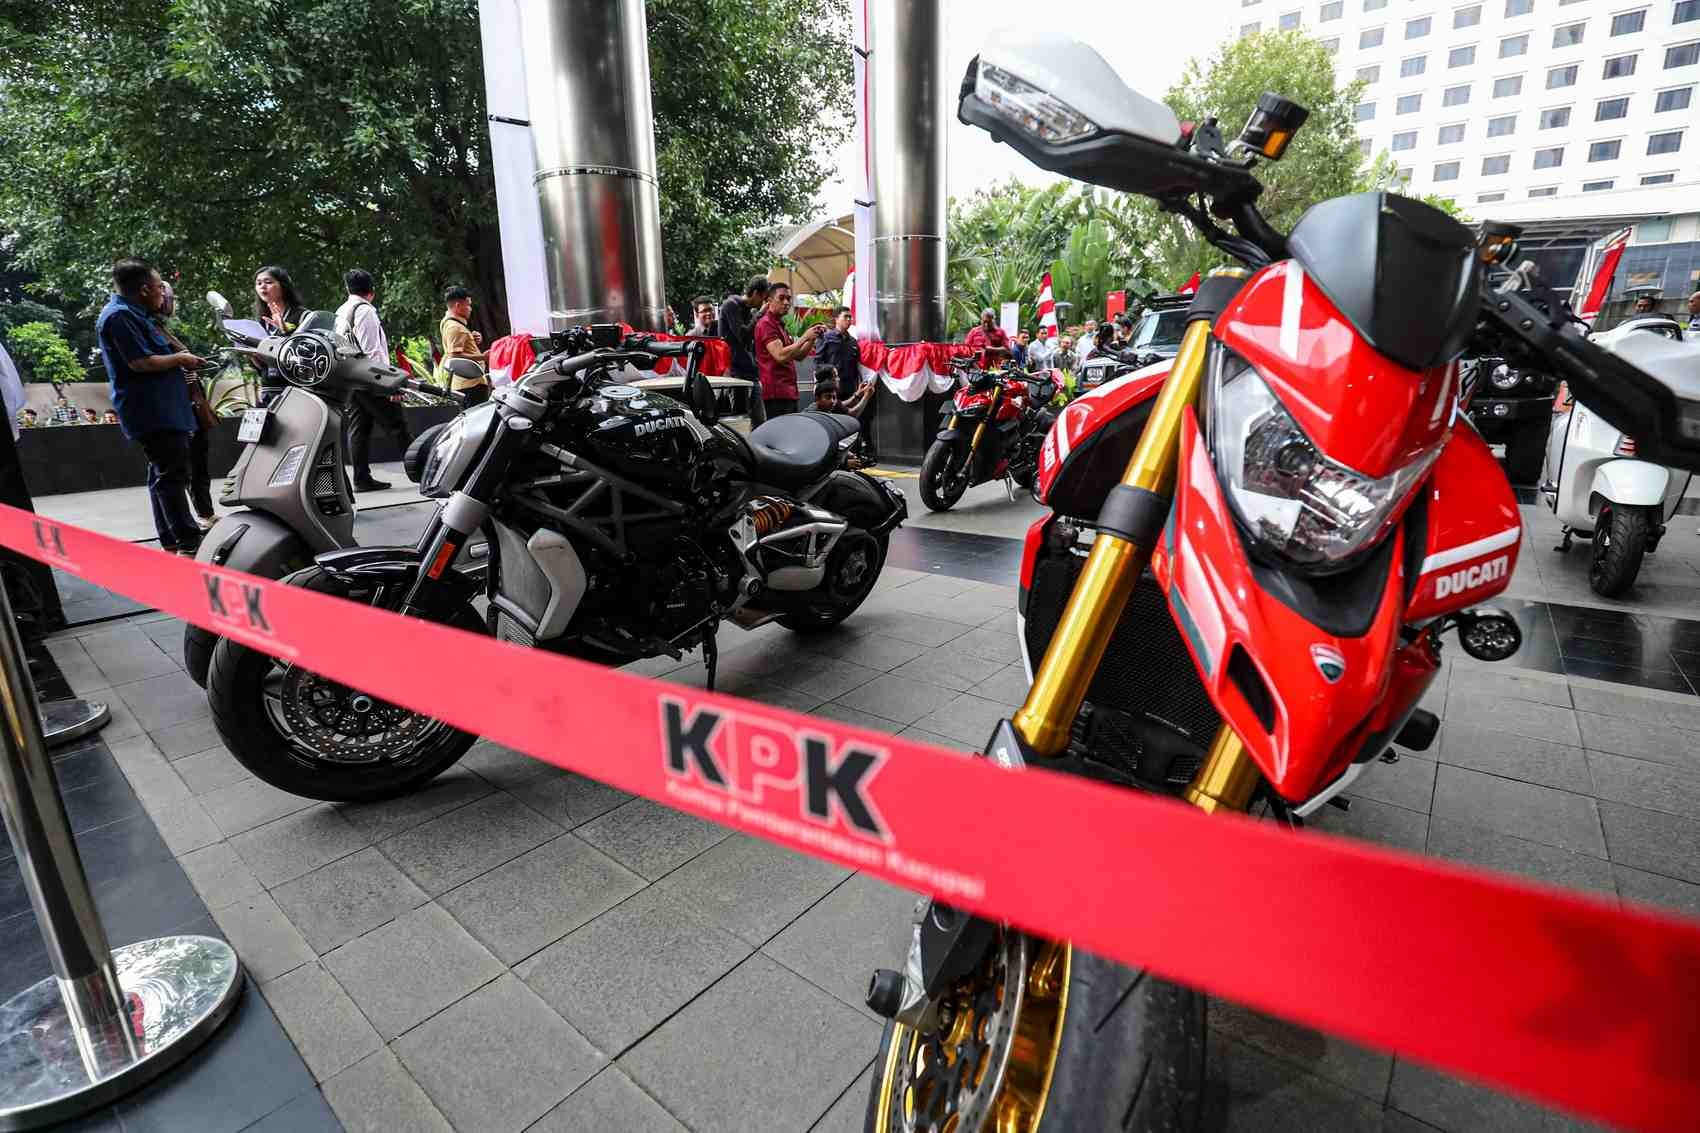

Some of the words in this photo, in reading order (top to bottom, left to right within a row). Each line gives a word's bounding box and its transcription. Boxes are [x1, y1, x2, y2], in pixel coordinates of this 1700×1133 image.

[634, 416, 686, 437] DUCATI
[1435, 555, 1509, 600] DUCATI
[657, 695, 895, 845] KPK
